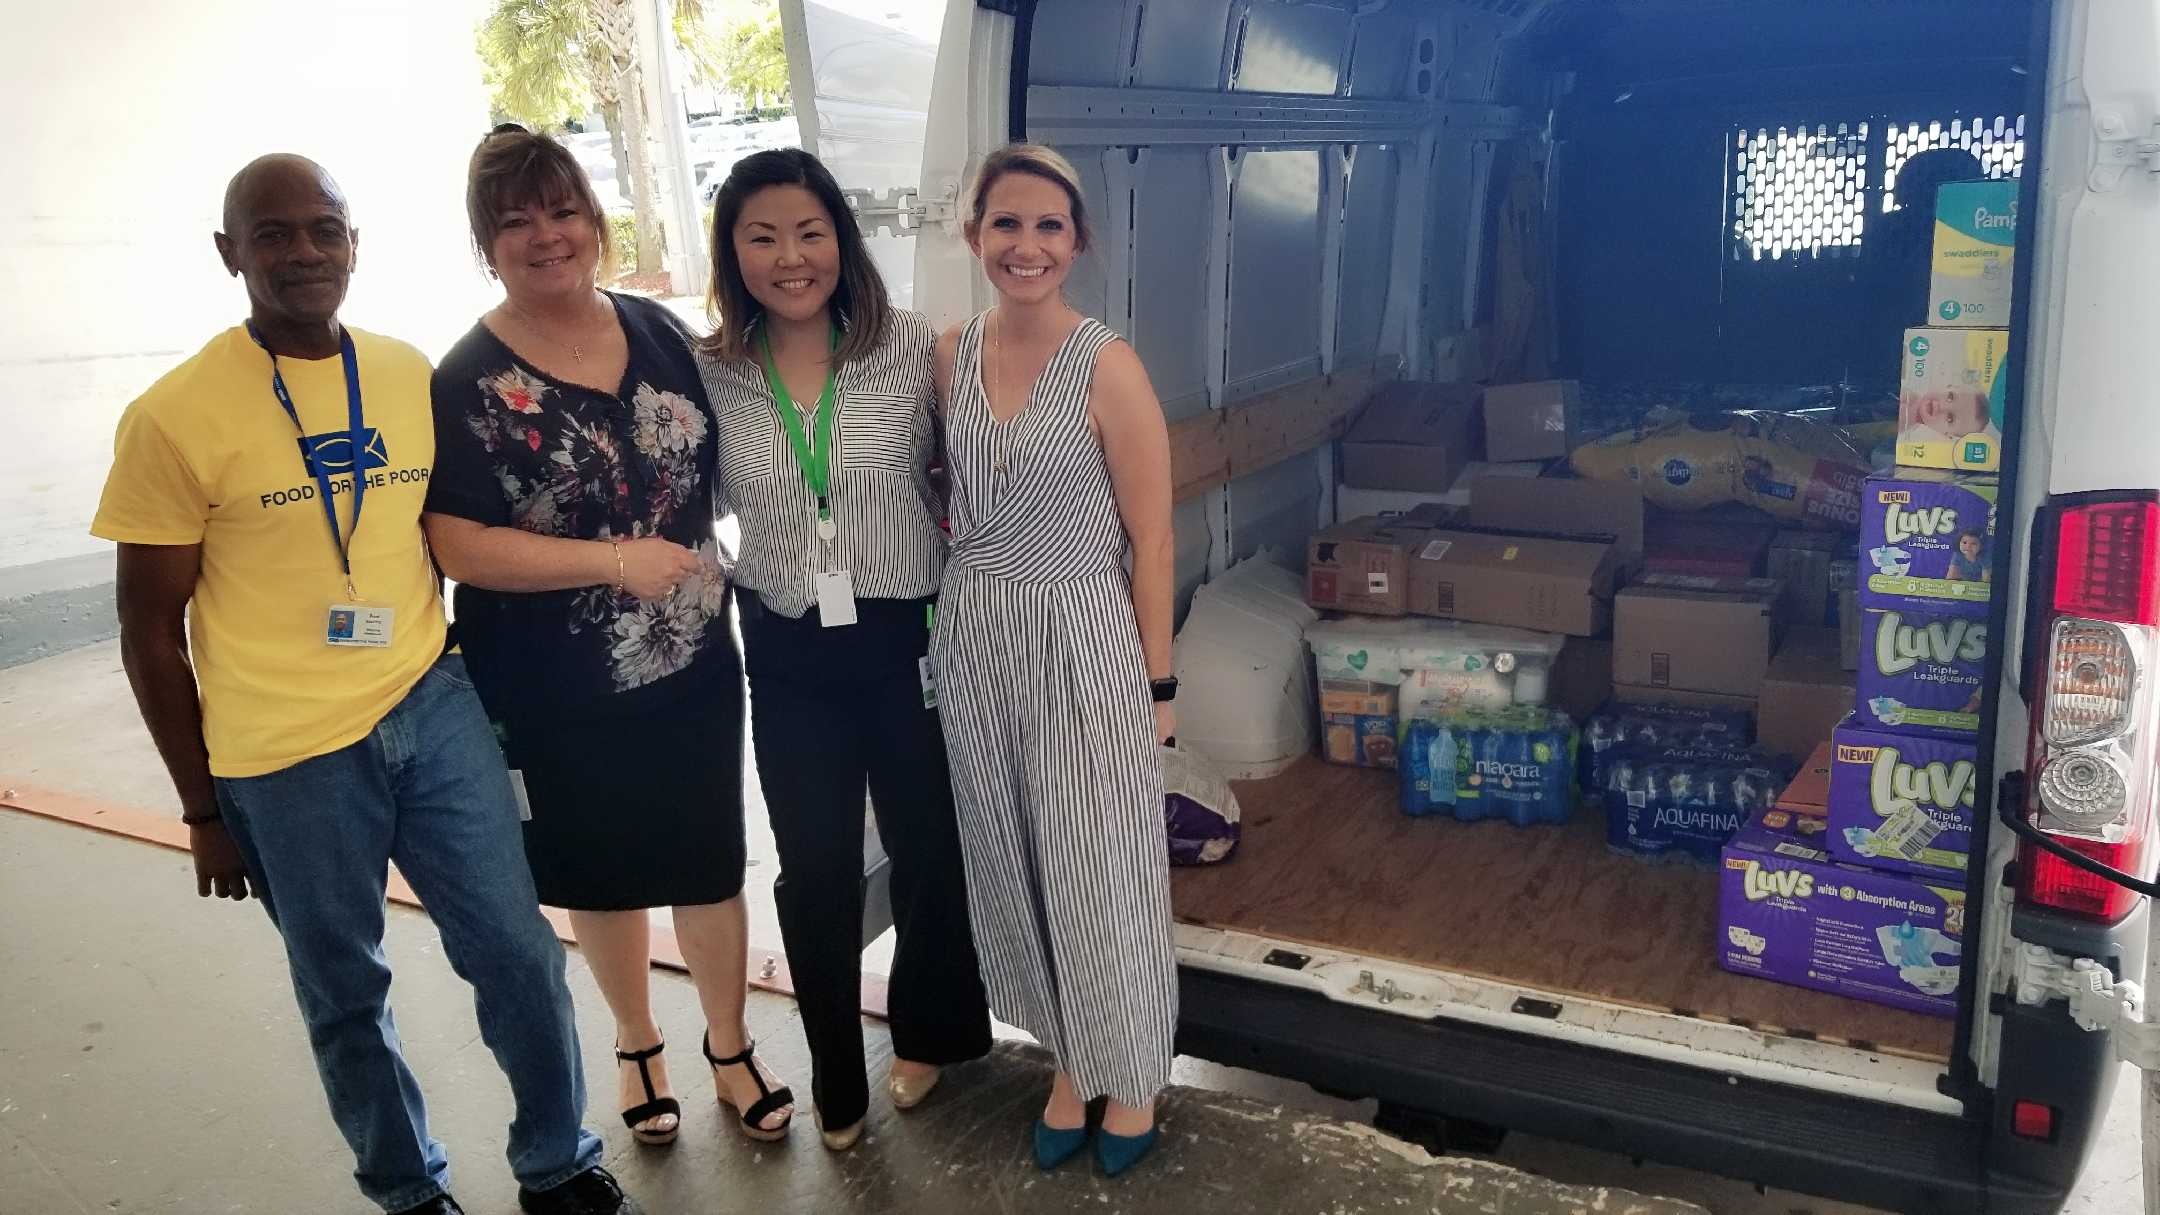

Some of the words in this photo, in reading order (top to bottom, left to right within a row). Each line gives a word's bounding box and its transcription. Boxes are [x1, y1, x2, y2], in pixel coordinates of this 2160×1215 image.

[1974, 206, 2017, 231] Pamp
[1962, 303, 1985, 314] 100
[1914, 358, 1925, 378] 100
[260, 485, 315, 509] FOOD
[321, 479, 351, 497] OR
[352, 473, 385, 490] HE
[389, 468, 429, 485] POOR
[1883, 491, 1909, 502] NEW!
[1885, 503, 1957, 544] Luvs
[1913, 671, 1979, 685] Leakguards
[1927, 664, 1959, 675] Triple
[1839, 748, 1873, 763] NEW!
[1475, 759, 1541, 780] niagara
[1654, 807, 1741, 832] AQUAFINA
[1927, 808, 1962, 823] Triple
[1744, 861, 1814, 900] Luvs
[1817, 884, 1838, 898] with
[1856, 889, 1908, 911] Absorption
[1909, 900, 1937, 916] Areas
